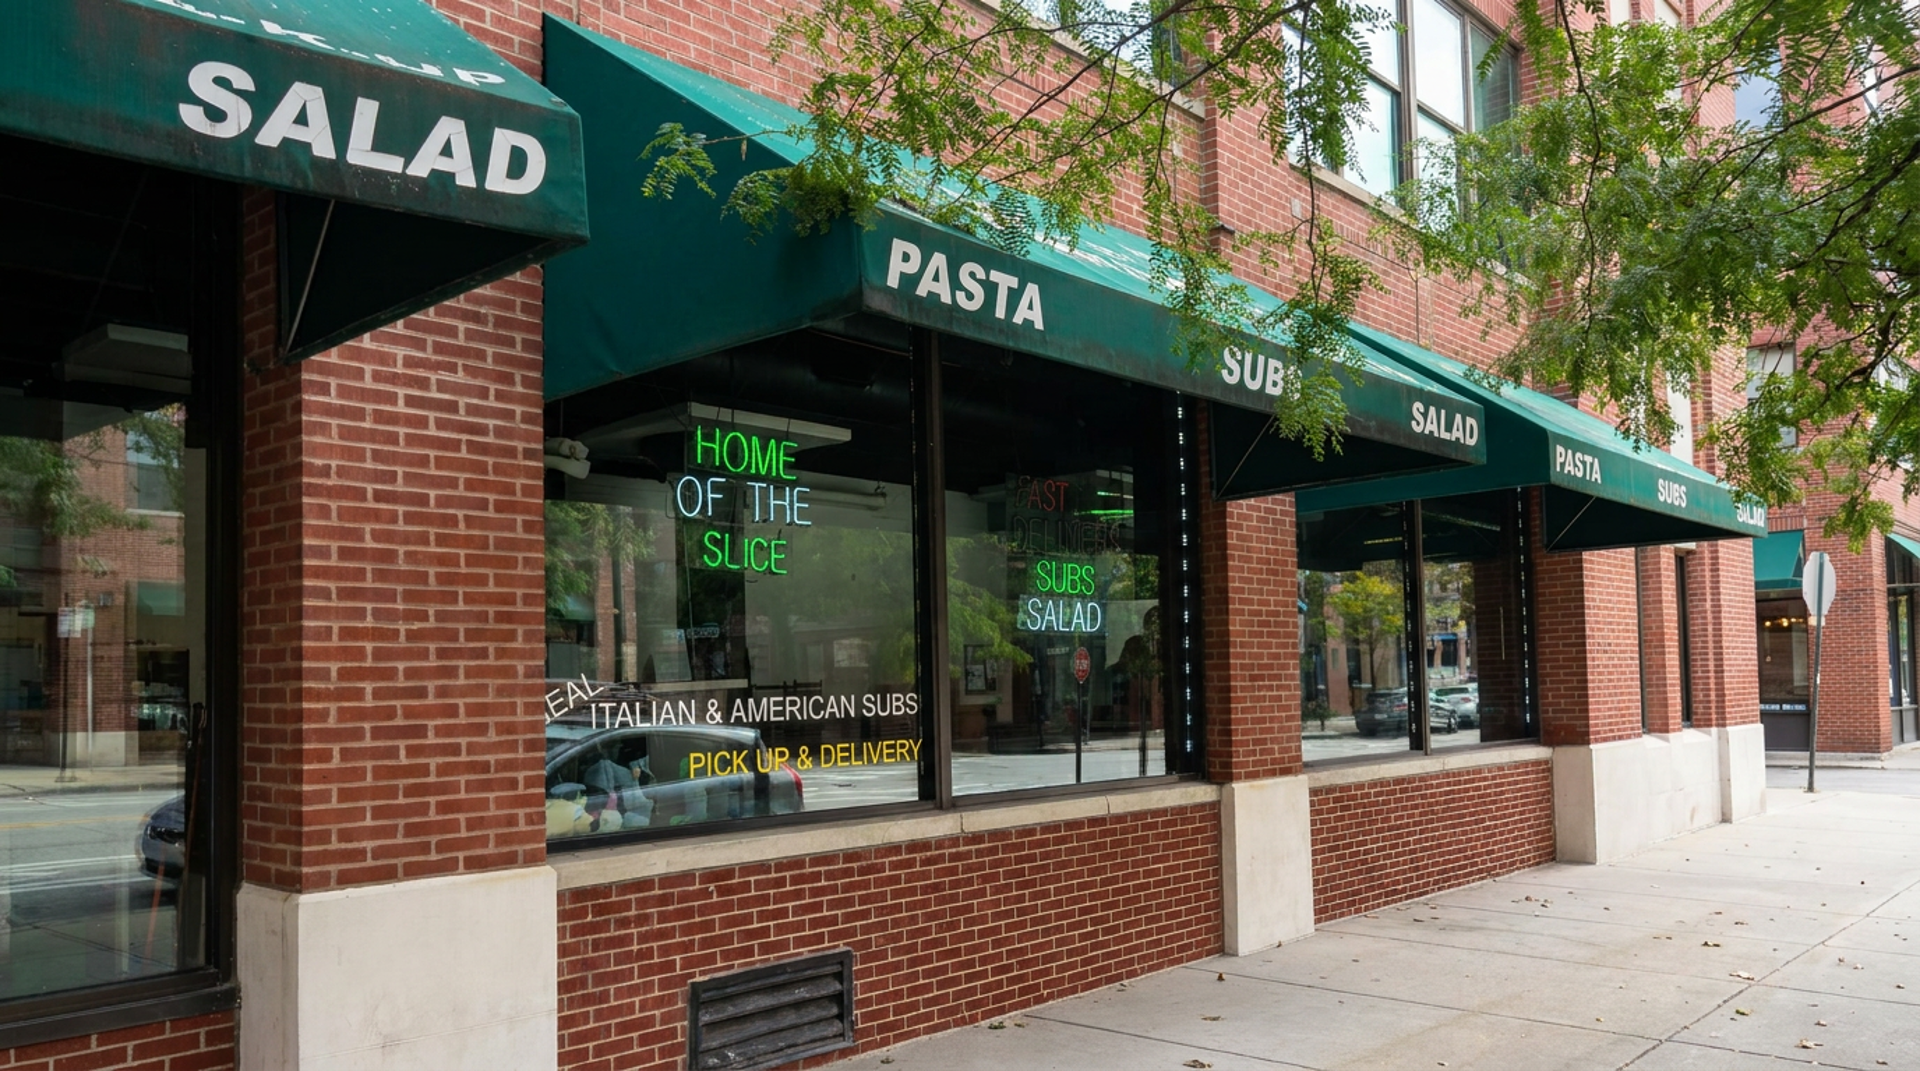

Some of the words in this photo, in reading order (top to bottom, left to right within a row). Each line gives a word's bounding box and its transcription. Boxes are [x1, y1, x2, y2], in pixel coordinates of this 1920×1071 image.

[178, 61, 547, 195] SALAD
[886, 238, 1044, 331] PASTA
[1411, 401, 1479, 446] SALAD
[697, 425, 798, 480] HOME
[1556, 444, 1602, 485] PASTA
[1657, 478, 1687, 508] SUBS
[677, 475, 727, 517] OF
[746, 481, 812, 526] THE
[703, 531, 788, 575] SLICE
[1036, 560, 1095, 595] SUBS
[1026, 598, 1102, 632] SALAD
[591, 700, 696, 730] ITALIAN
[705, 698, 723, 725] &
[730, 694, 855, 723] AMERICAN
[862, 692, 918, 717] SUBS
[689, 750, 749, 779] PICK
[756, 747, 790, 774] UP
[797, 745, 813, 770] &
[820, 738, 923, 768] DELIVERY
